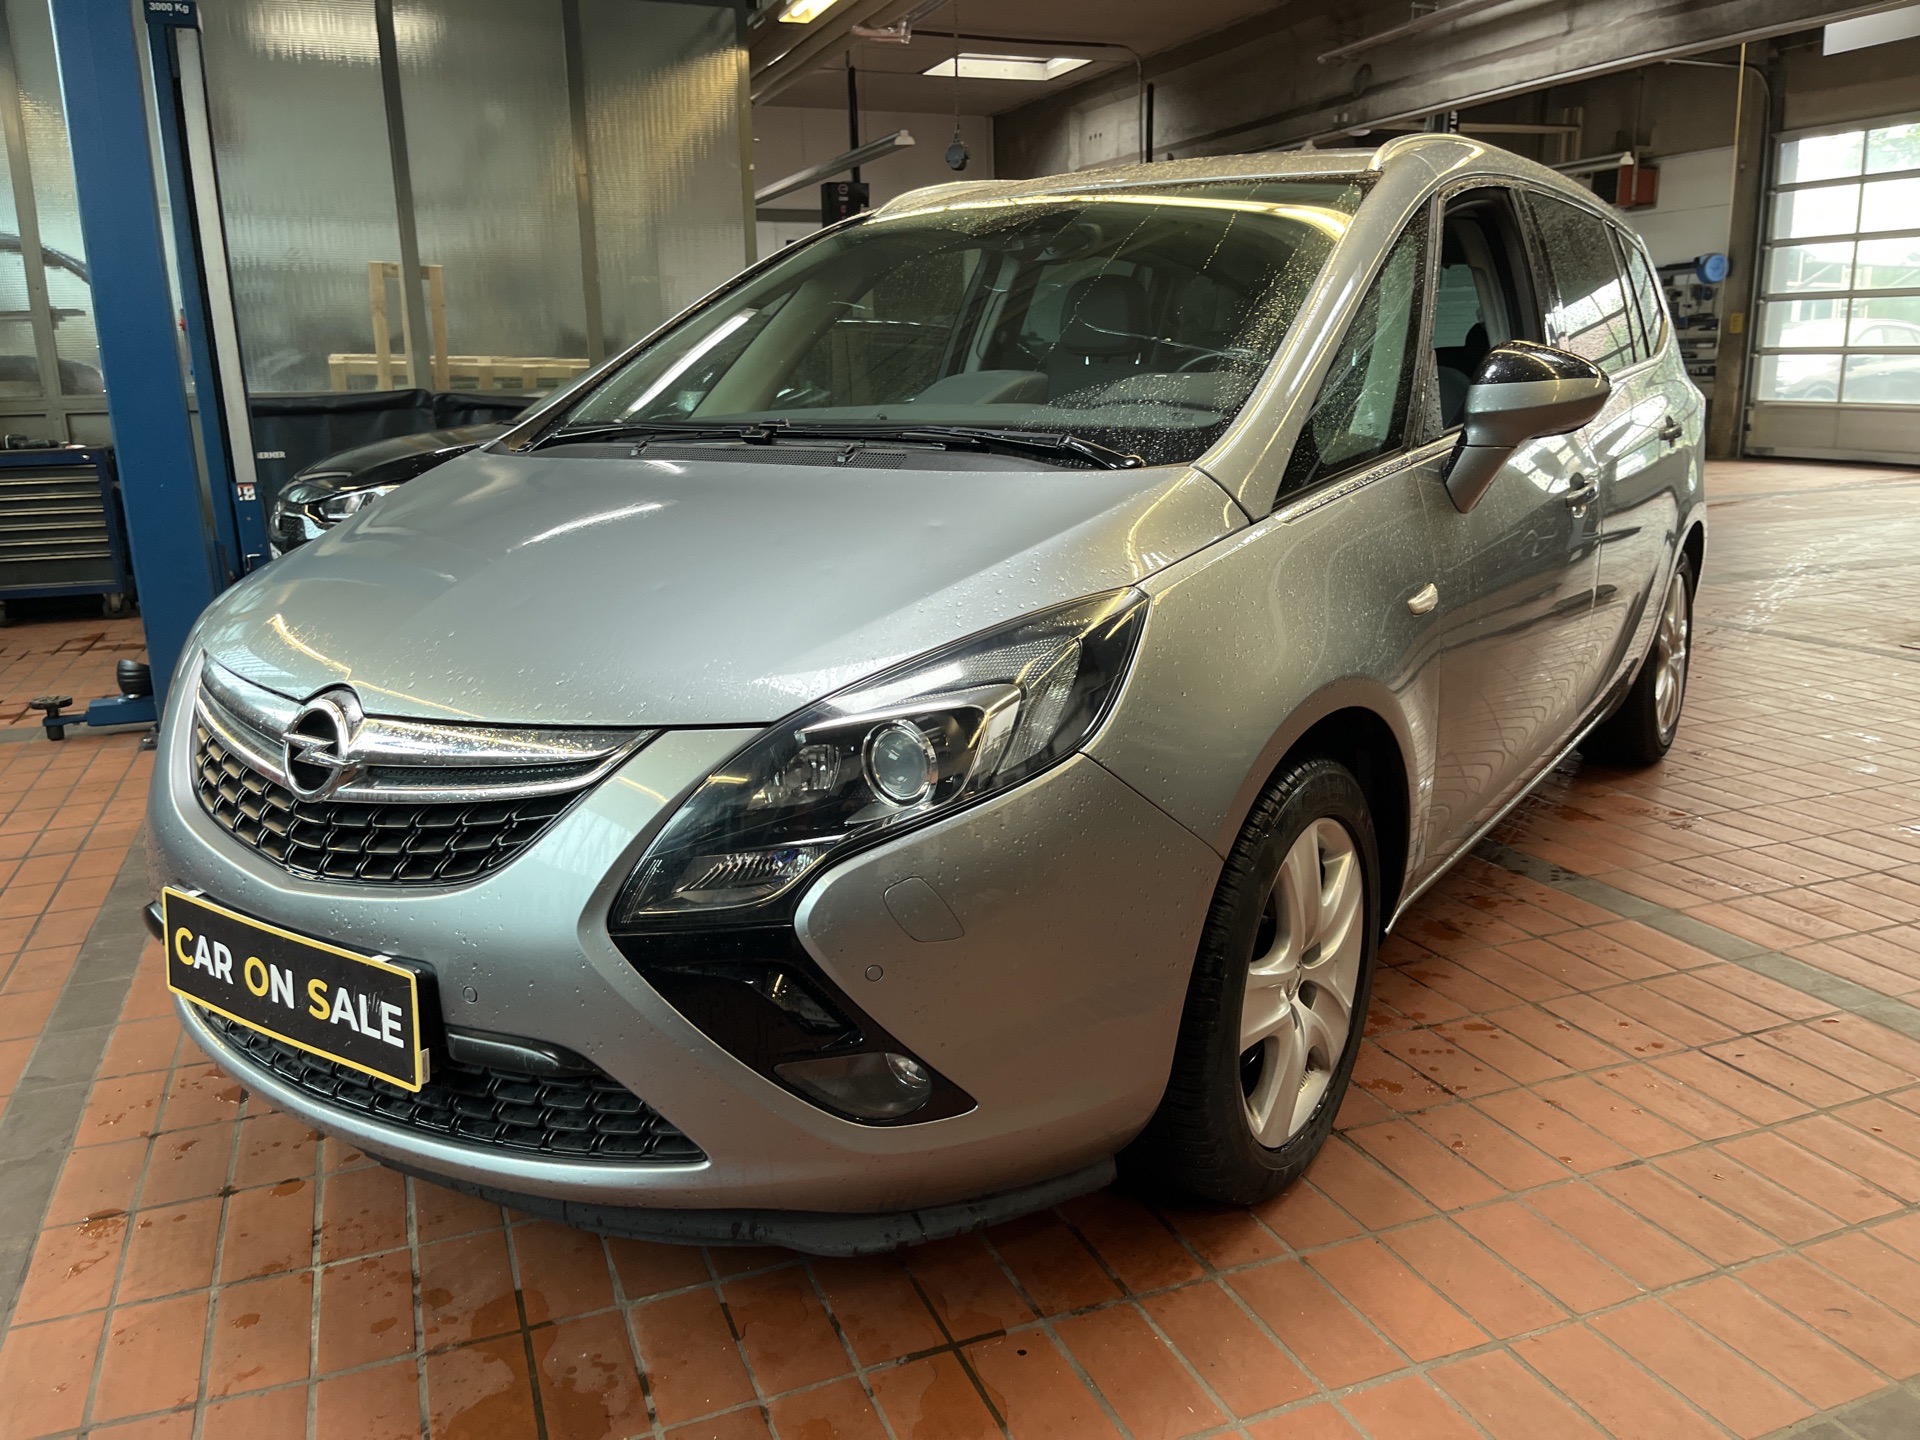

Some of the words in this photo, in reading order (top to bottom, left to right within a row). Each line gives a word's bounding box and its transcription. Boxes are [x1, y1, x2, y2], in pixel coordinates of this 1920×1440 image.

[150, 2, 173, 11] 3000
[174, 3, 189, 14] Kg
[175, 927, 234, 985] CAR
[244, 956, 295, 1009] ON
[307, 978, 404, 1049] SALE
